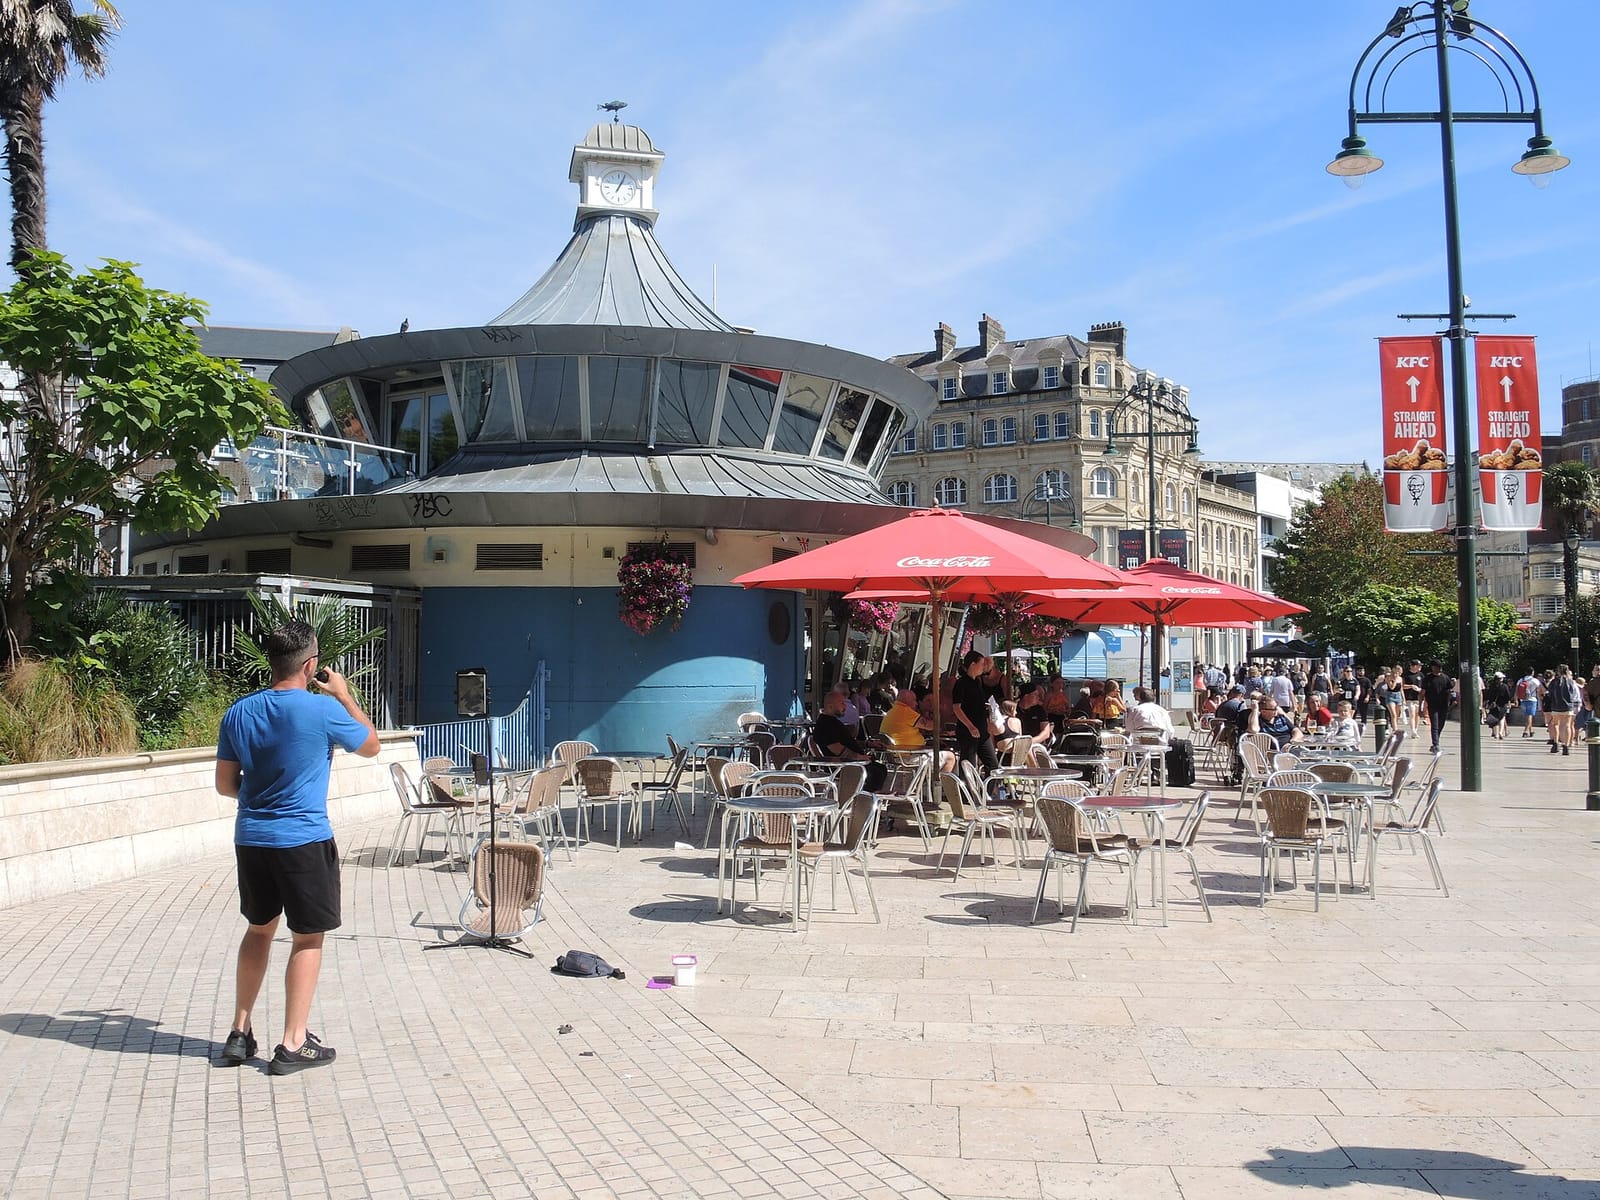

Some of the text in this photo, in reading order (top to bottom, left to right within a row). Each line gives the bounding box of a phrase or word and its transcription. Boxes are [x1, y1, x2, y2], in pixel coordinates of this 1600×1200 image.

[1396, 356, 1430, 368] KFC
[1490, 356, 1523, 368] KFC
[1394, 411, 1435, 422] STRAIGHT
[1488, 411, 1530, 422] STRAIGHT
[1395, 423, 1436, 438] AHEAD
[1489, 423, 1530, 438] AHEAD
[896, 556, 993, 567] Coca-Cola
